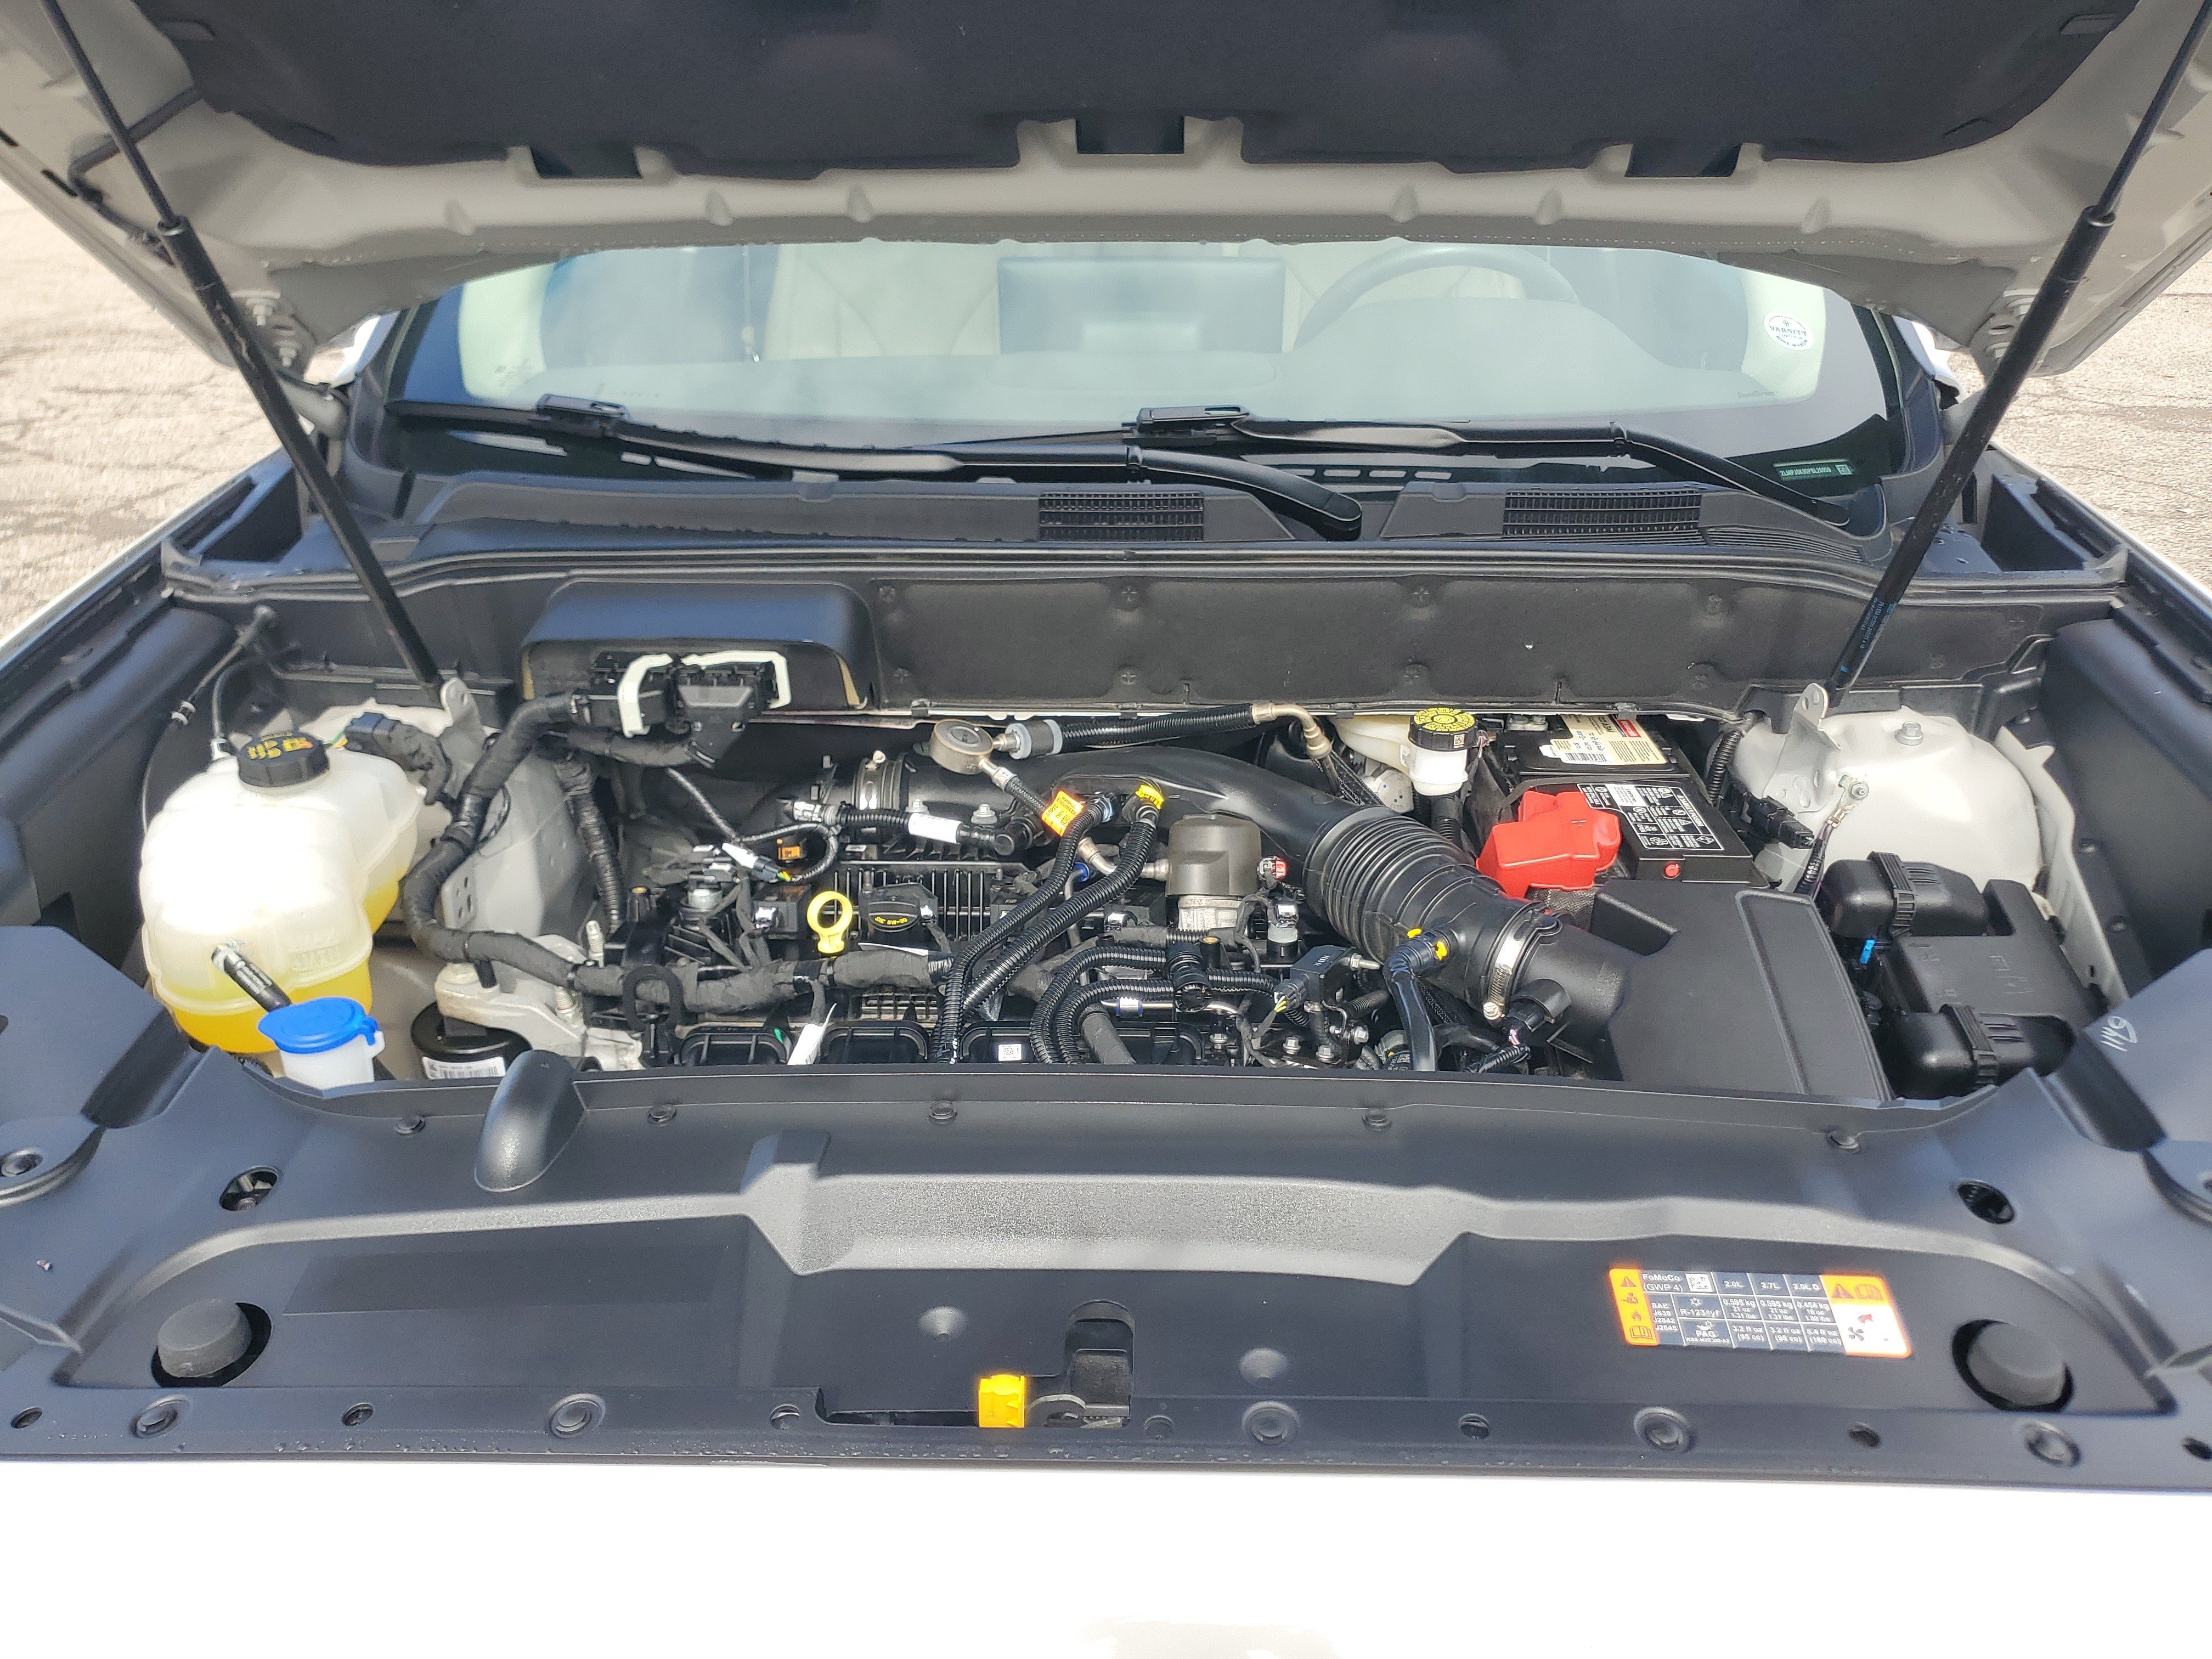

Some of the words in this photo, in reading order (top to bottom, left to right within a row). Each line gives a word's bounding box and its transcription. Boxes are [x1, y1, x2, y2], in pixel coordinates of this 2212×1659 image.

[1642, 1273, 1681, 1282] FoMoCo
[1673, 1284, 1683, 1292] 4)
[1818, 1302, 1830, 1311] kg
[1695, 1330, 1717, 1338] PAG
